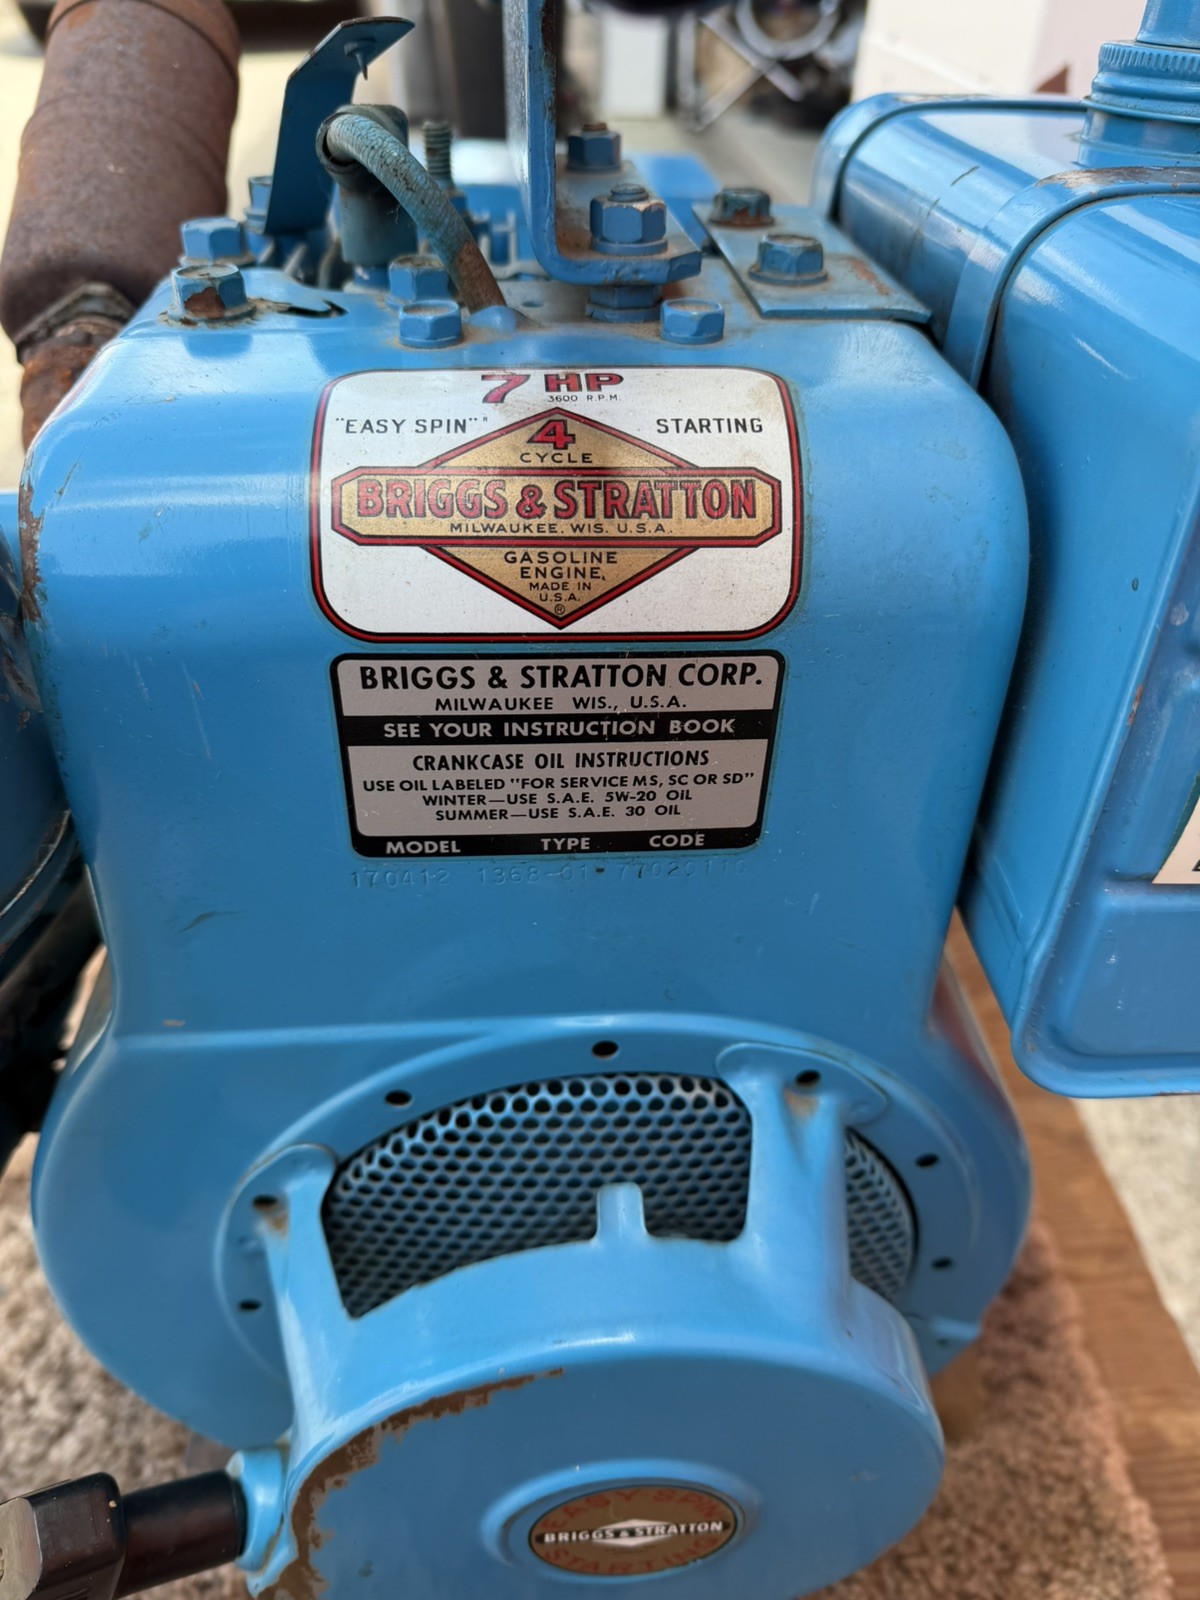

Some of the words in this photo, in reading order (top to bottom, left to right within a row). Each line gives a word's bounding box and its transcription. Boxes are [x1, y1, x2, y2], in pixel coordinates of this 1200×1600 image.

[481, 374, 531, 403] 7
[544, 373, 624, 392] HP
[548, 394, 578, 402] 3600
[586, 394, 622, 402] R.P.M.
[656, 417, 763, 434] STARTING
[526, 419, 576, 450] 4
[520, 452, 593, 464] CYCLE
[357, 478, 508, 519] BRIGGS
[516, 484, 548, 519] &
[553, 479, 756, 520] STRATTON
[570, 523, 609, 534] WIS.
[617, 523, 673, 534] U.S.A.
[504, 551, 618, 564] GASOLINE
[529, 582, 570, 591] MADE
[577, 582, 592, 591] IN
[539, 593, 581, 602] U.S.A.
[359, 666, 476, 690] BRIGGS
[487, 665, 508, 689] &
[520, 663, 667, 689] STRATTON
[678, 662, 763, 687] CORP.
[435, 697, 554, 711] MILWAUKEE
[572, 696, 618, 711] WIS.,
[630, 695, 688, 709] U.S.A.
[383, 723, 421, 738] SEE
[429, 723, 493, 738] YOUR
[503, 720, 656, 737] INSTRUCTION
[669, 718, 737, 735] BOOK
[412, 754, 524, 771] CRANKCASE
[534, 753, 565, 769] OIL
[575, 750, 710, 768] INSTRUCTIONS
[363, 780, 395, 792] USE
[399, 780, 428, 791] OIL
[432, 778, 506, 791] LABELED
[560, 776, 629, 789] SERVICE
[632, 775, 664, 788] MS,
[668, 774, 689, 786] SC
[693, 774, 718, 785] OR
[547, 792, 595, 804] S.A.E.
[604, 790, 657, 802] 5W-20
[666, 790, 693, 801] OIL
[568, 807, 615, 818] S.A.E.
[625, 806, 646, 817] 30
[654, 805, 681, 816] OIL
[386, 840, 461, 854] MODEL
[541, 837, 590, 850] TYPE
[649, 834, 705, 848] CODE
[351, 868, 450, 889] 170412
[543, 1528, 615, 1544] BRIGGS
[619, 1529, 630, 1538] &
[634, 1520, 724, 1538] STRATTON
